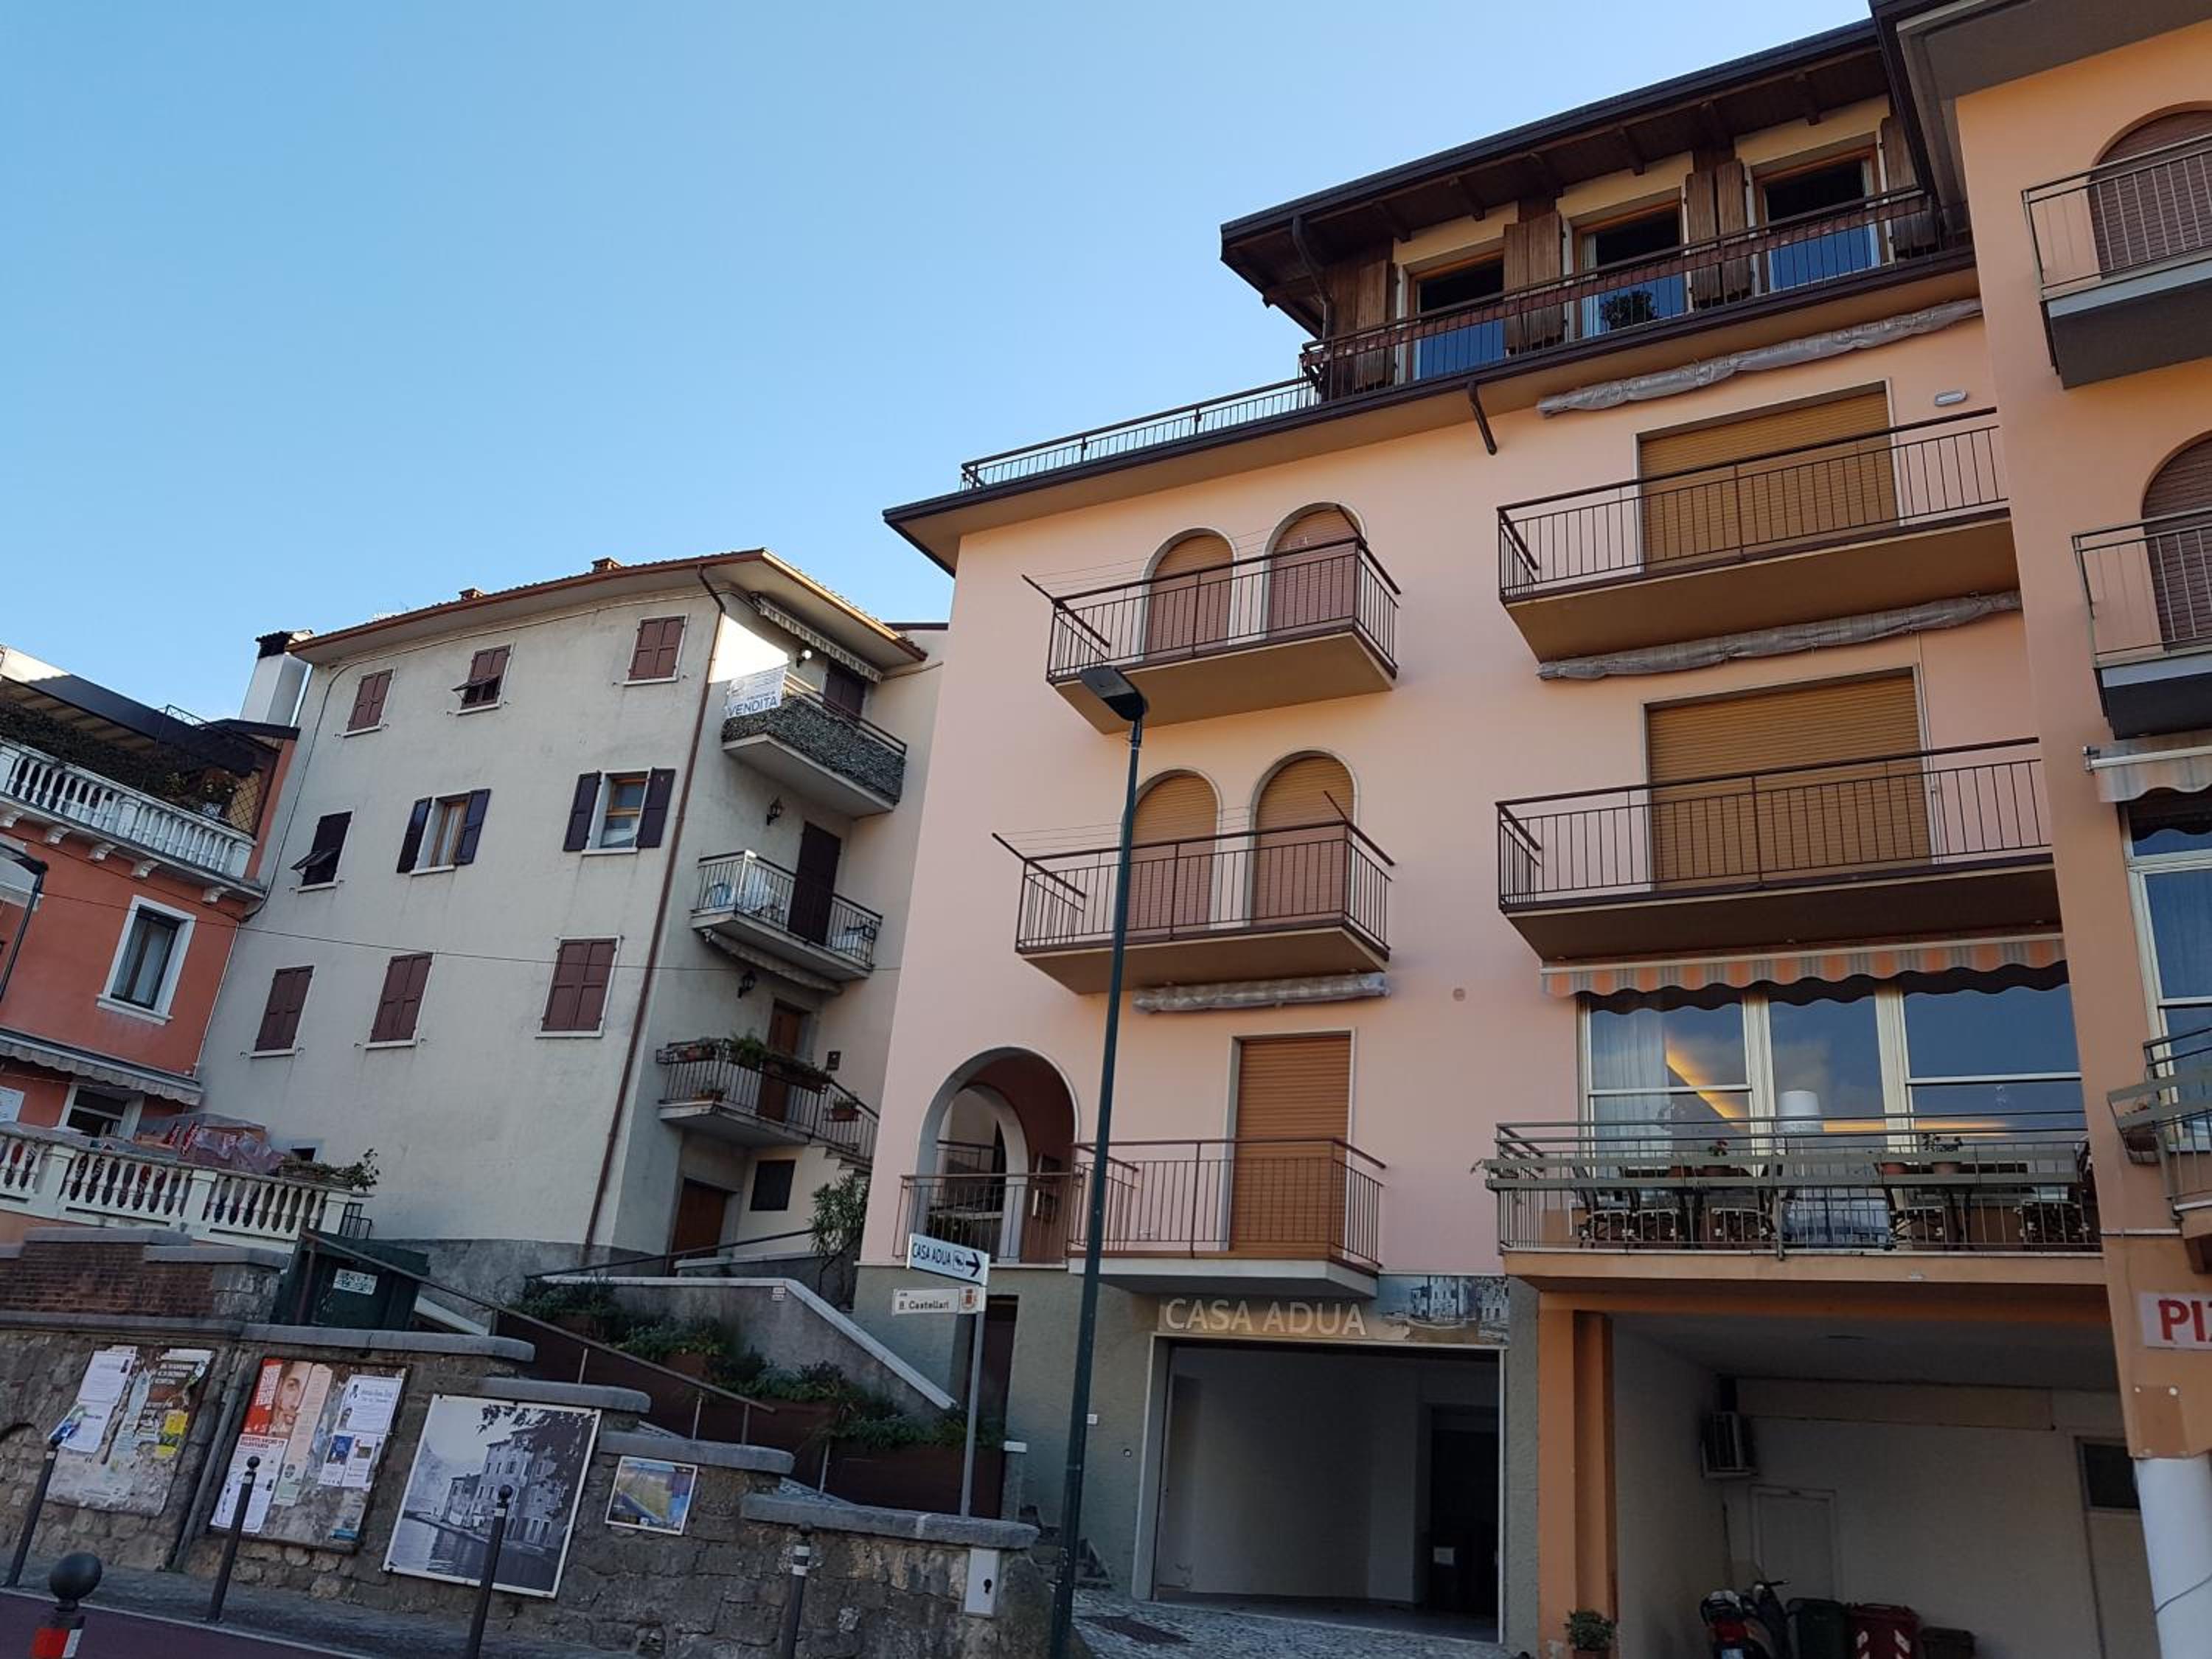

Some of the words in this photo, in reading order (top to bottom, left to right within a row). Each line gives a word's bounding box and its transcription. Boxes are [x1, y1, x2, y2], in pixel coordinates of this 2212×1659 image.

[728, 696, 777, 717] VENDITA
[912, 1242, 930, 1259] CASA
[932, 1248, 951, 1265] ADUA
[1166, 1298, 1253, 1332] CASA
[1262, 1301, 1366, 1335] ADUA
[2157, 1298, 2212, 1342] PI
